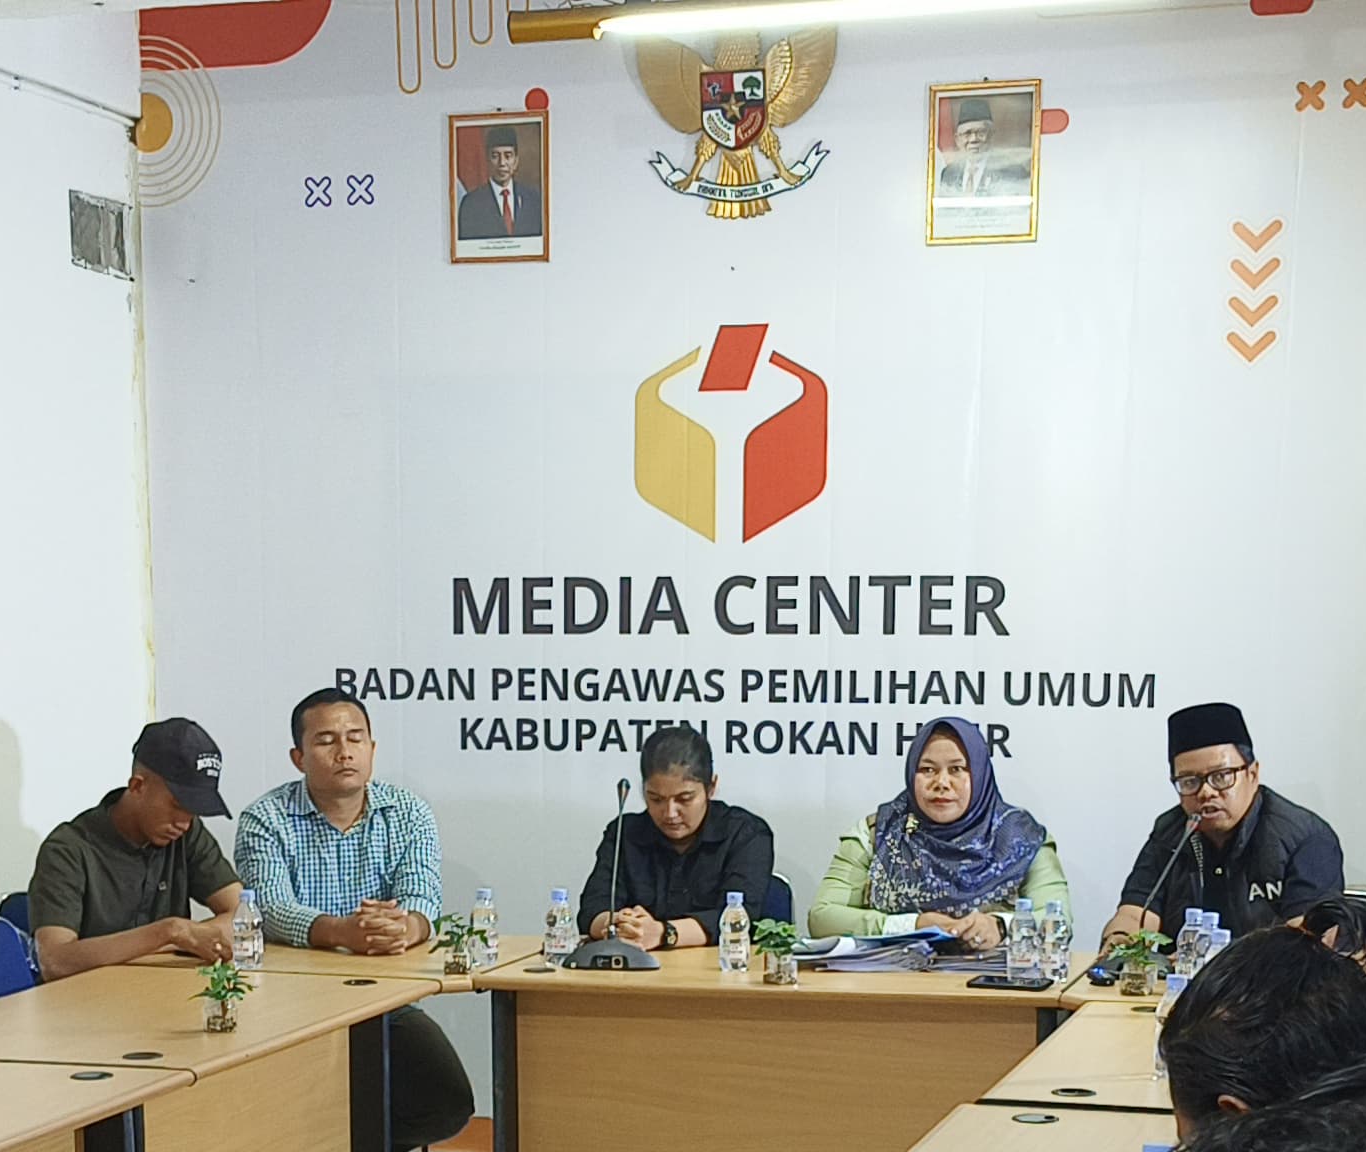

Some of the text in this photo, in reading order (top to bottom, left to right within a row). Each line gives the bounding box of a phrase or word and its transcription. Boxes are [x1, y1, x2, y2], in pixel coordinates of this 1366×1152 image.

[451, 573, 1011, 637] MEDIA CENTER
[335, 666, 1158, 709] BADAN PENGAWAS PEMILIHAN UMUM
[725, 720, 879, 757] ROKAN
[1248, 880, 1283, 902] AN
